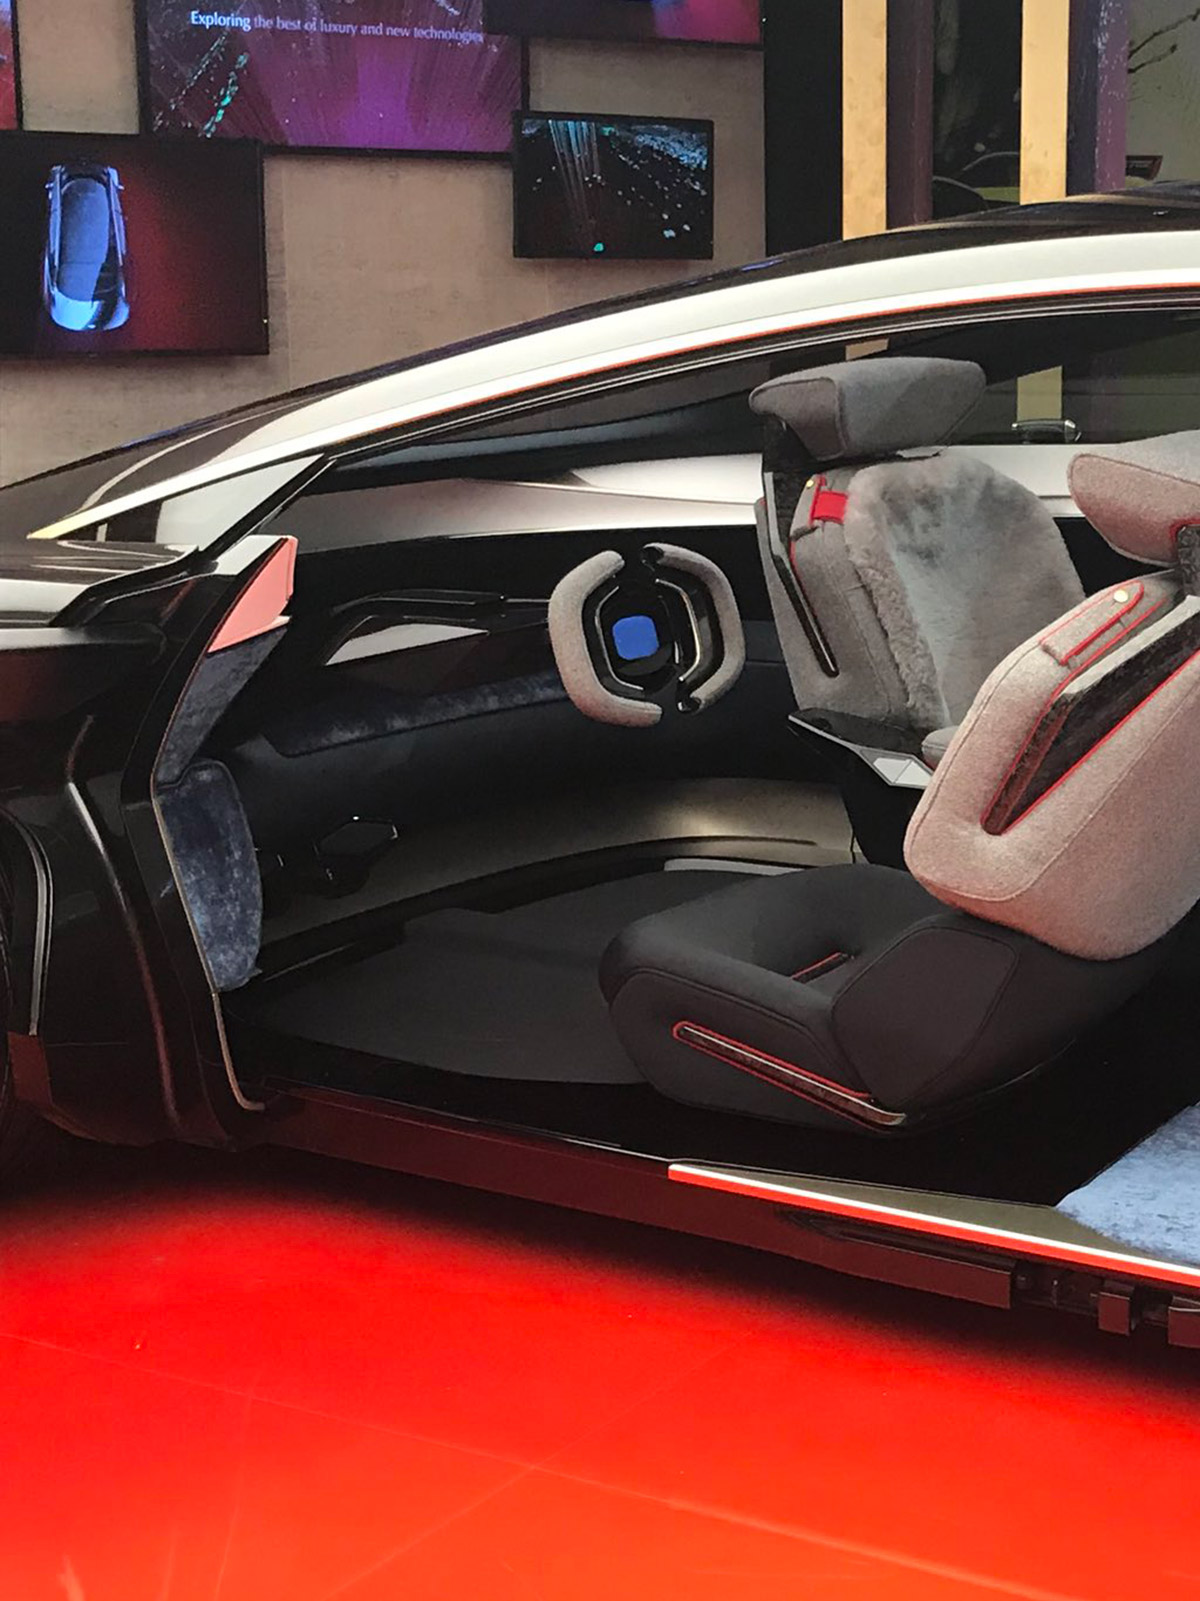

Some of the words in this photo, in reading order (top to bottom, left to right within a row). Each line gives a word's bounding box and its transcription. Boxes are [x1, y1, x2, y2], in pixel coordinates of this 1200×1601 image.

[191, 10, 252, 32] Exploring
[254, 14, 274, 29] the
[276, 16, 302, 31] best
[304, 17, 318, 31] of
[320, 18, 358, 37] luxury
[361, 22, 383, 35] and
[386, 26, 410, 37] new
